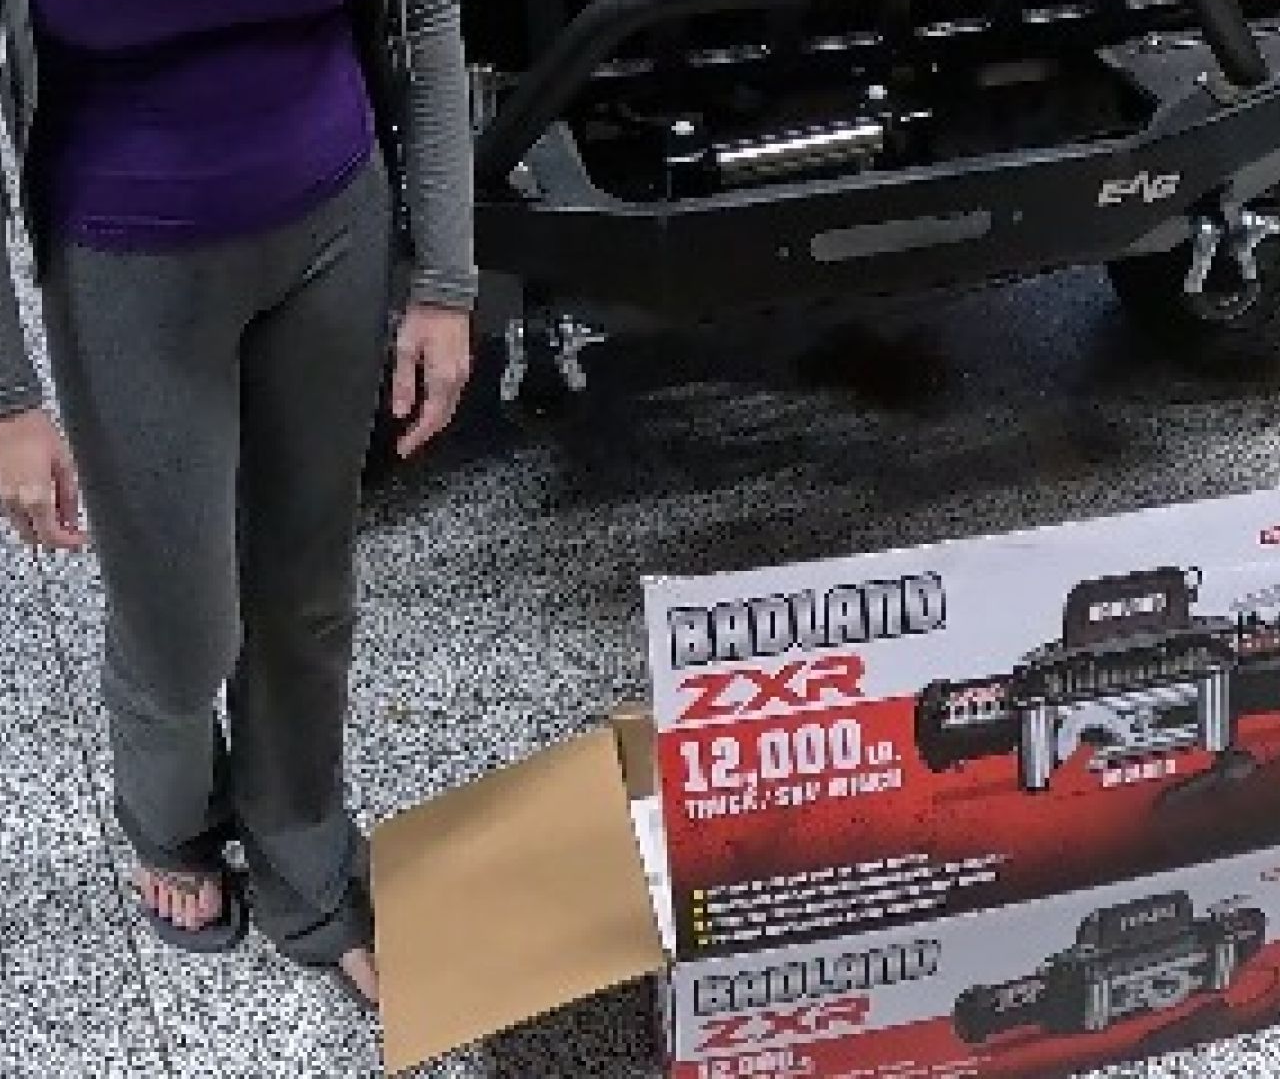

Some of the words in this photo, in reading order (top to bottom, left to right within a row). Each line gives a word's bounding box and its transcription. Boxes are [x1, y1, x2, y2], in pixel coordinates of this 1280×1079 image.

[668, 572, 947, 669] BADLAND
[677, 653, 866, 719] ZXR
[680, 719, 861, 795] 12,000
[693, 939, 942, 1016] BADLAND
[695, 996, 870, 1052] ZXR
